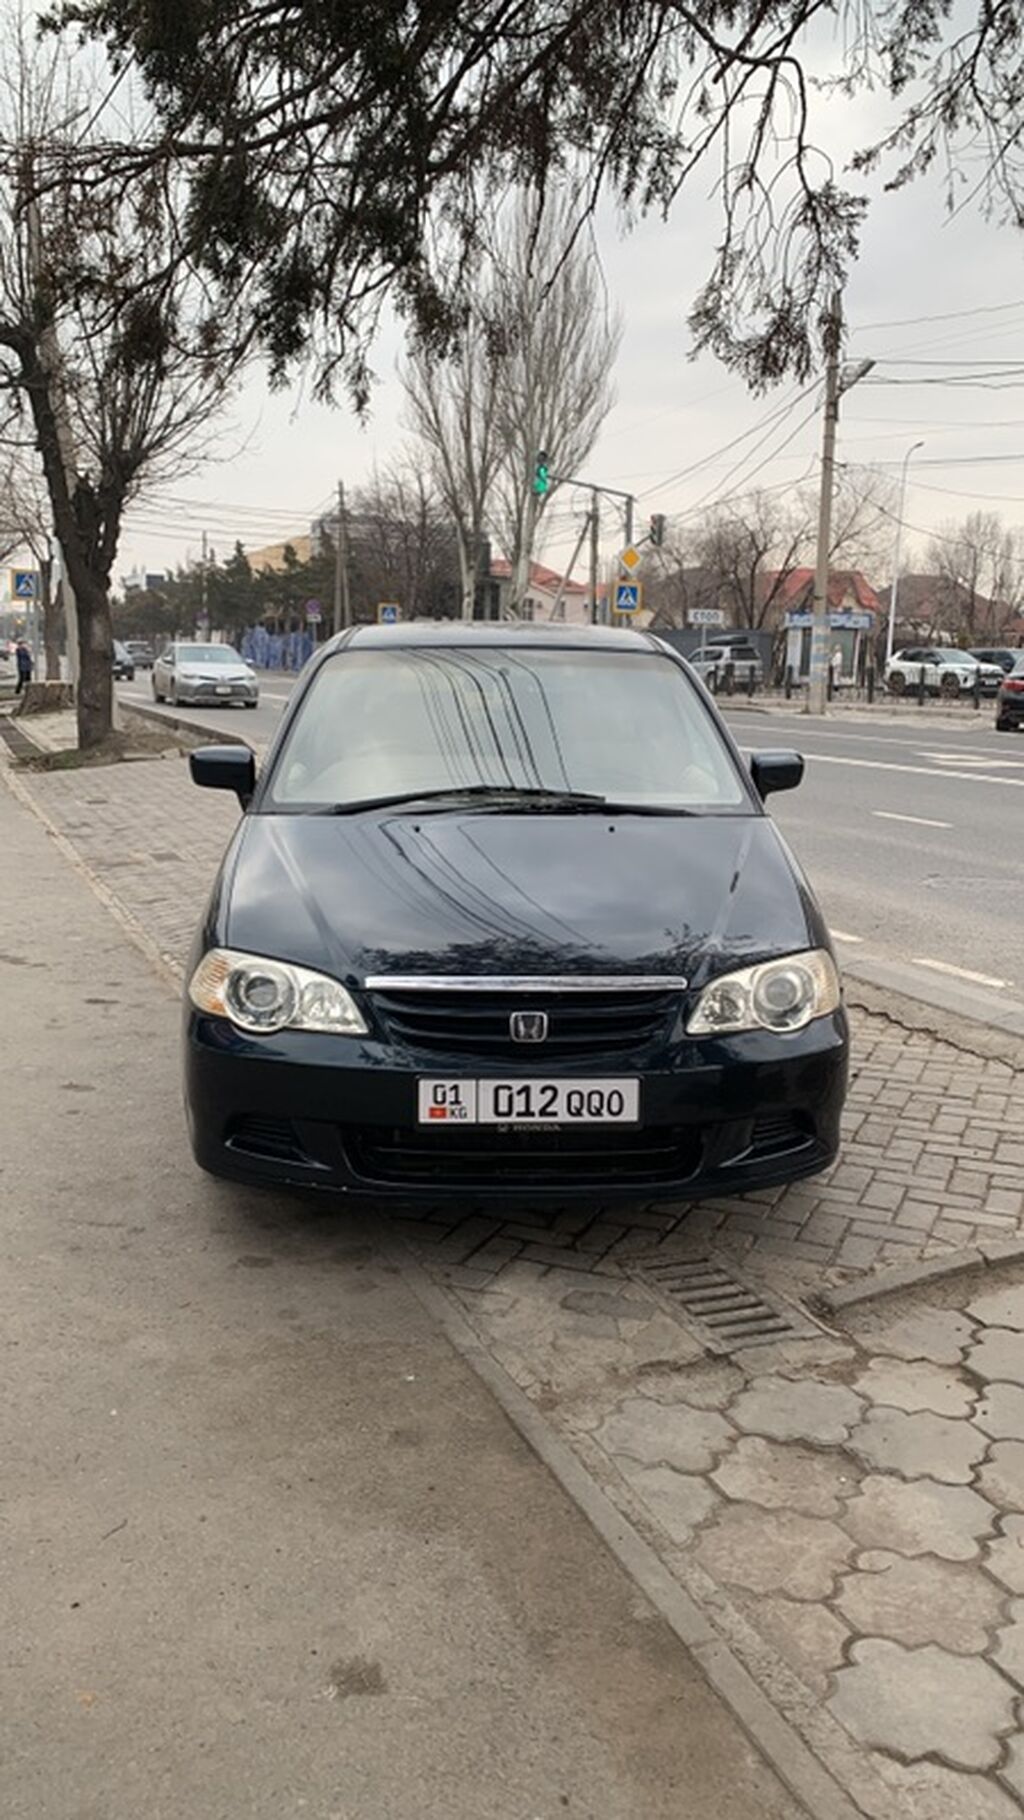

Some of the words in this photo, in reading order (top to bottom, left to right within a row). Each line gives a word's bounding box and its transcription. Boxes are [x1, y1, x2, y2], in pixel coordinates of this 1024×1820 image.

[433, 1083, 462, 1105] 01
[493, 1084, 559, 1118] 012
[449, 1106, 468, 1120] KG
